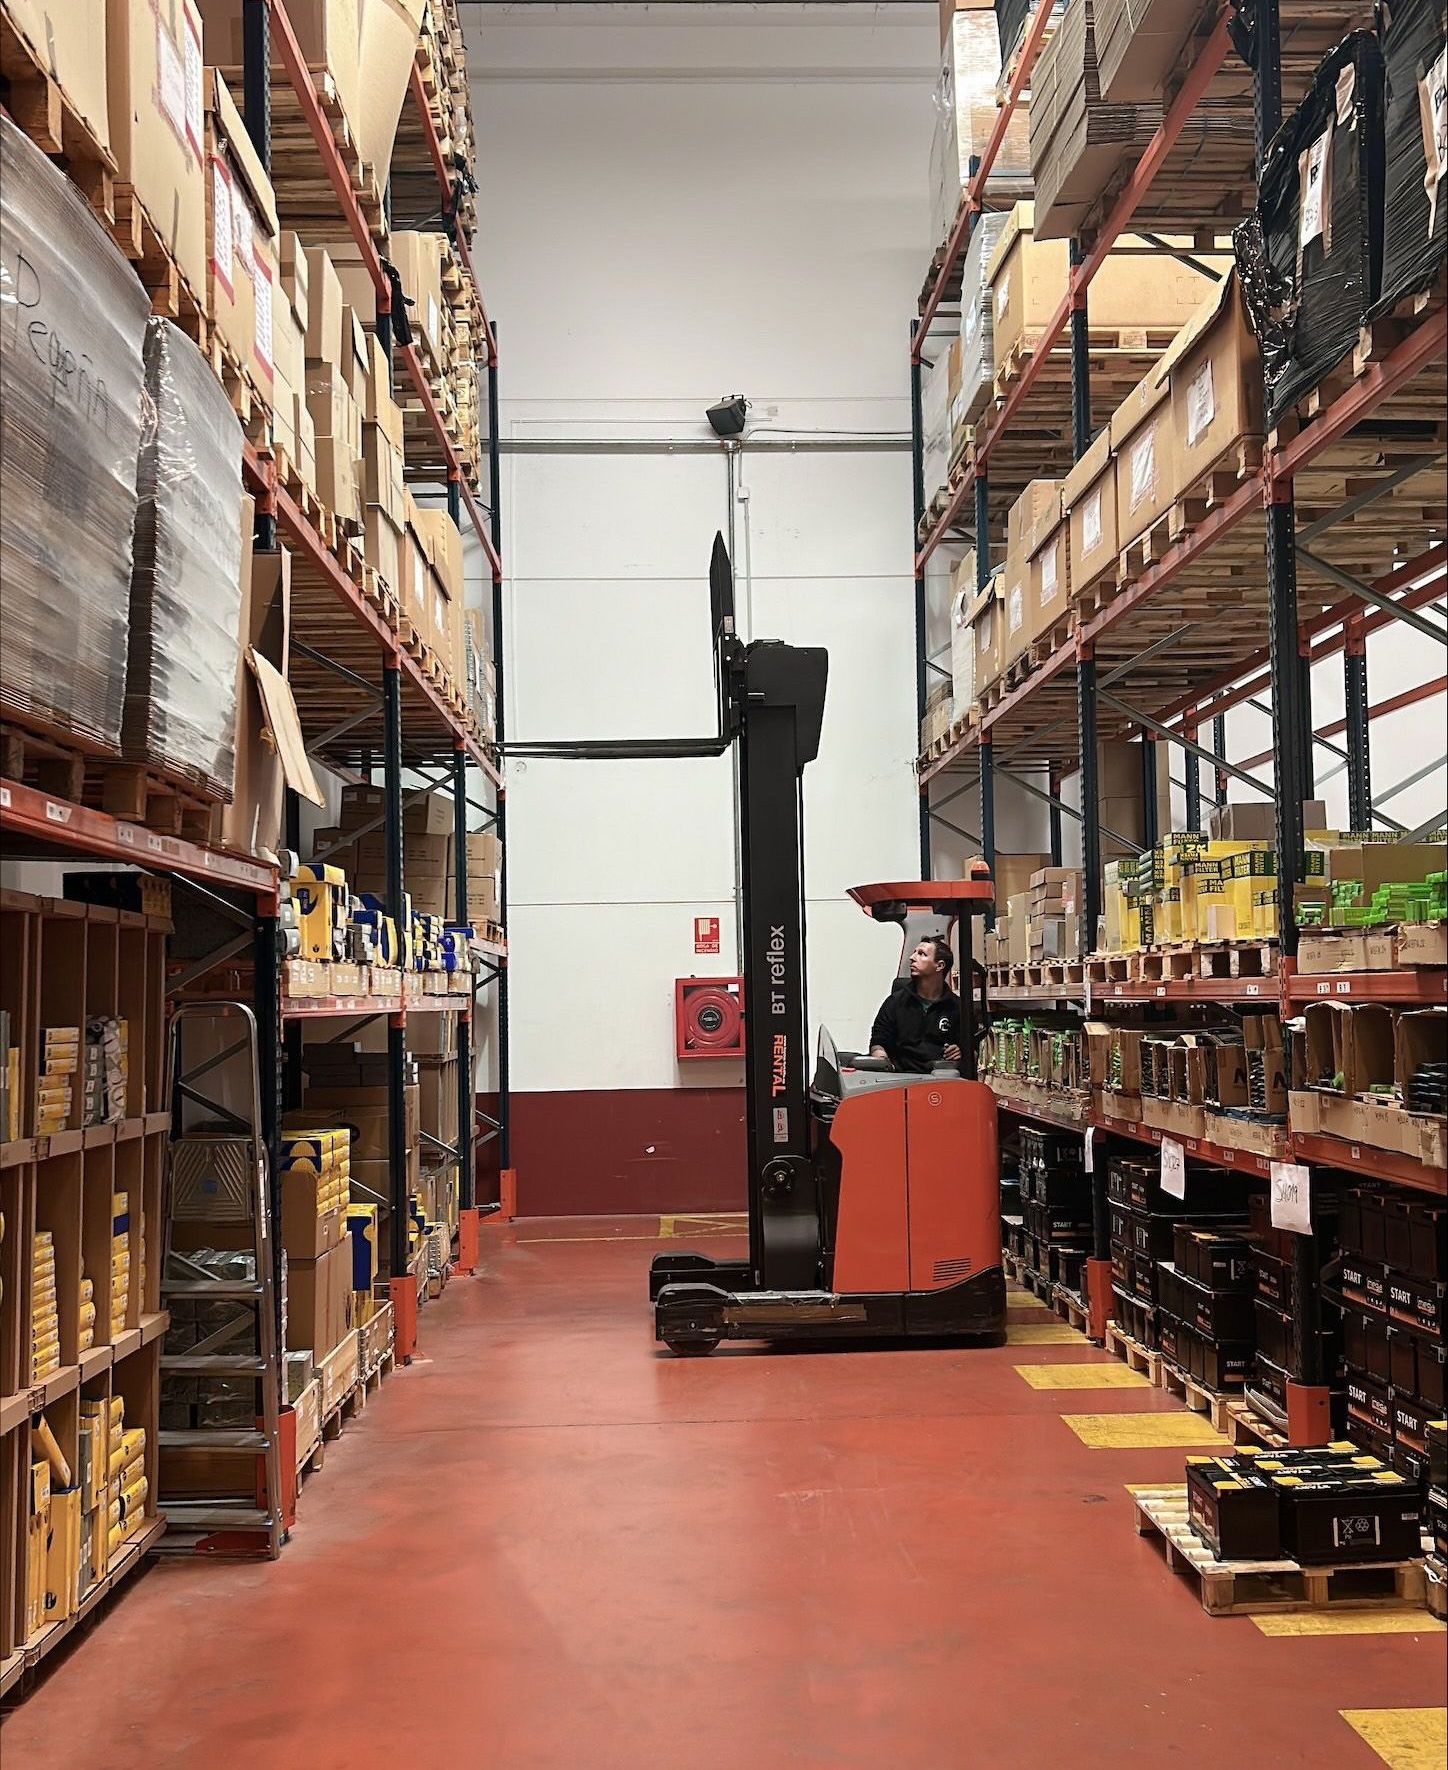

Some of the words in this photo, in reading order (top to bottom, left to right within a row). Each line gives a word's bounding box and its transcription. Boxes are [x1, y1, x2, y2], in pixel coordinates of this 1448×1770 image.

[1145, 907, 1153, 943] MANN
[766, 925, 785, 984] reflex
[772, 991, 785, 1014] BT
[772, 1035, 786, 1097] RENTAL
[1343, 1268, 1361, 1285] START
[1390, 1287, 1411, 1304] START
[1348, 1385, 1366, 1404] START
[1396, 1410, 1418, 1431] START
